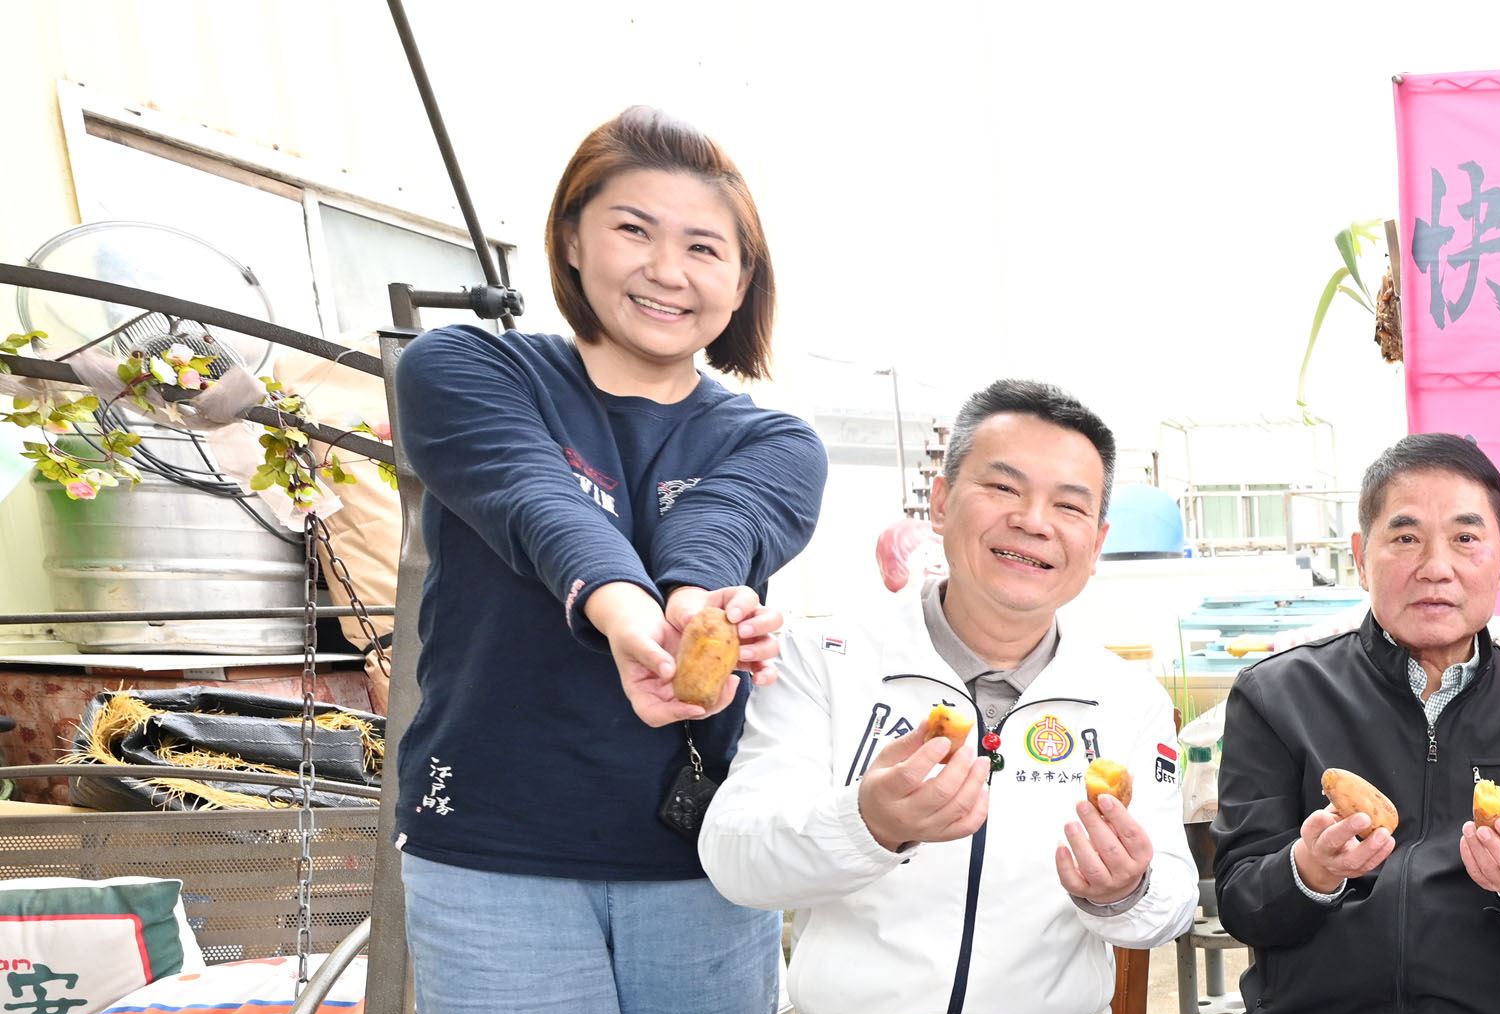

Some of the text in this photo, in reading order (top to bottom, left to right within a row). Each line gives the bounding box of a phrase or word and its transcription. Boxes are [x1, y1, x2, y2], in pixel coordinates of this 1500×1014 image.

[1016, 769, 1083, 784] 苗栗市公所
